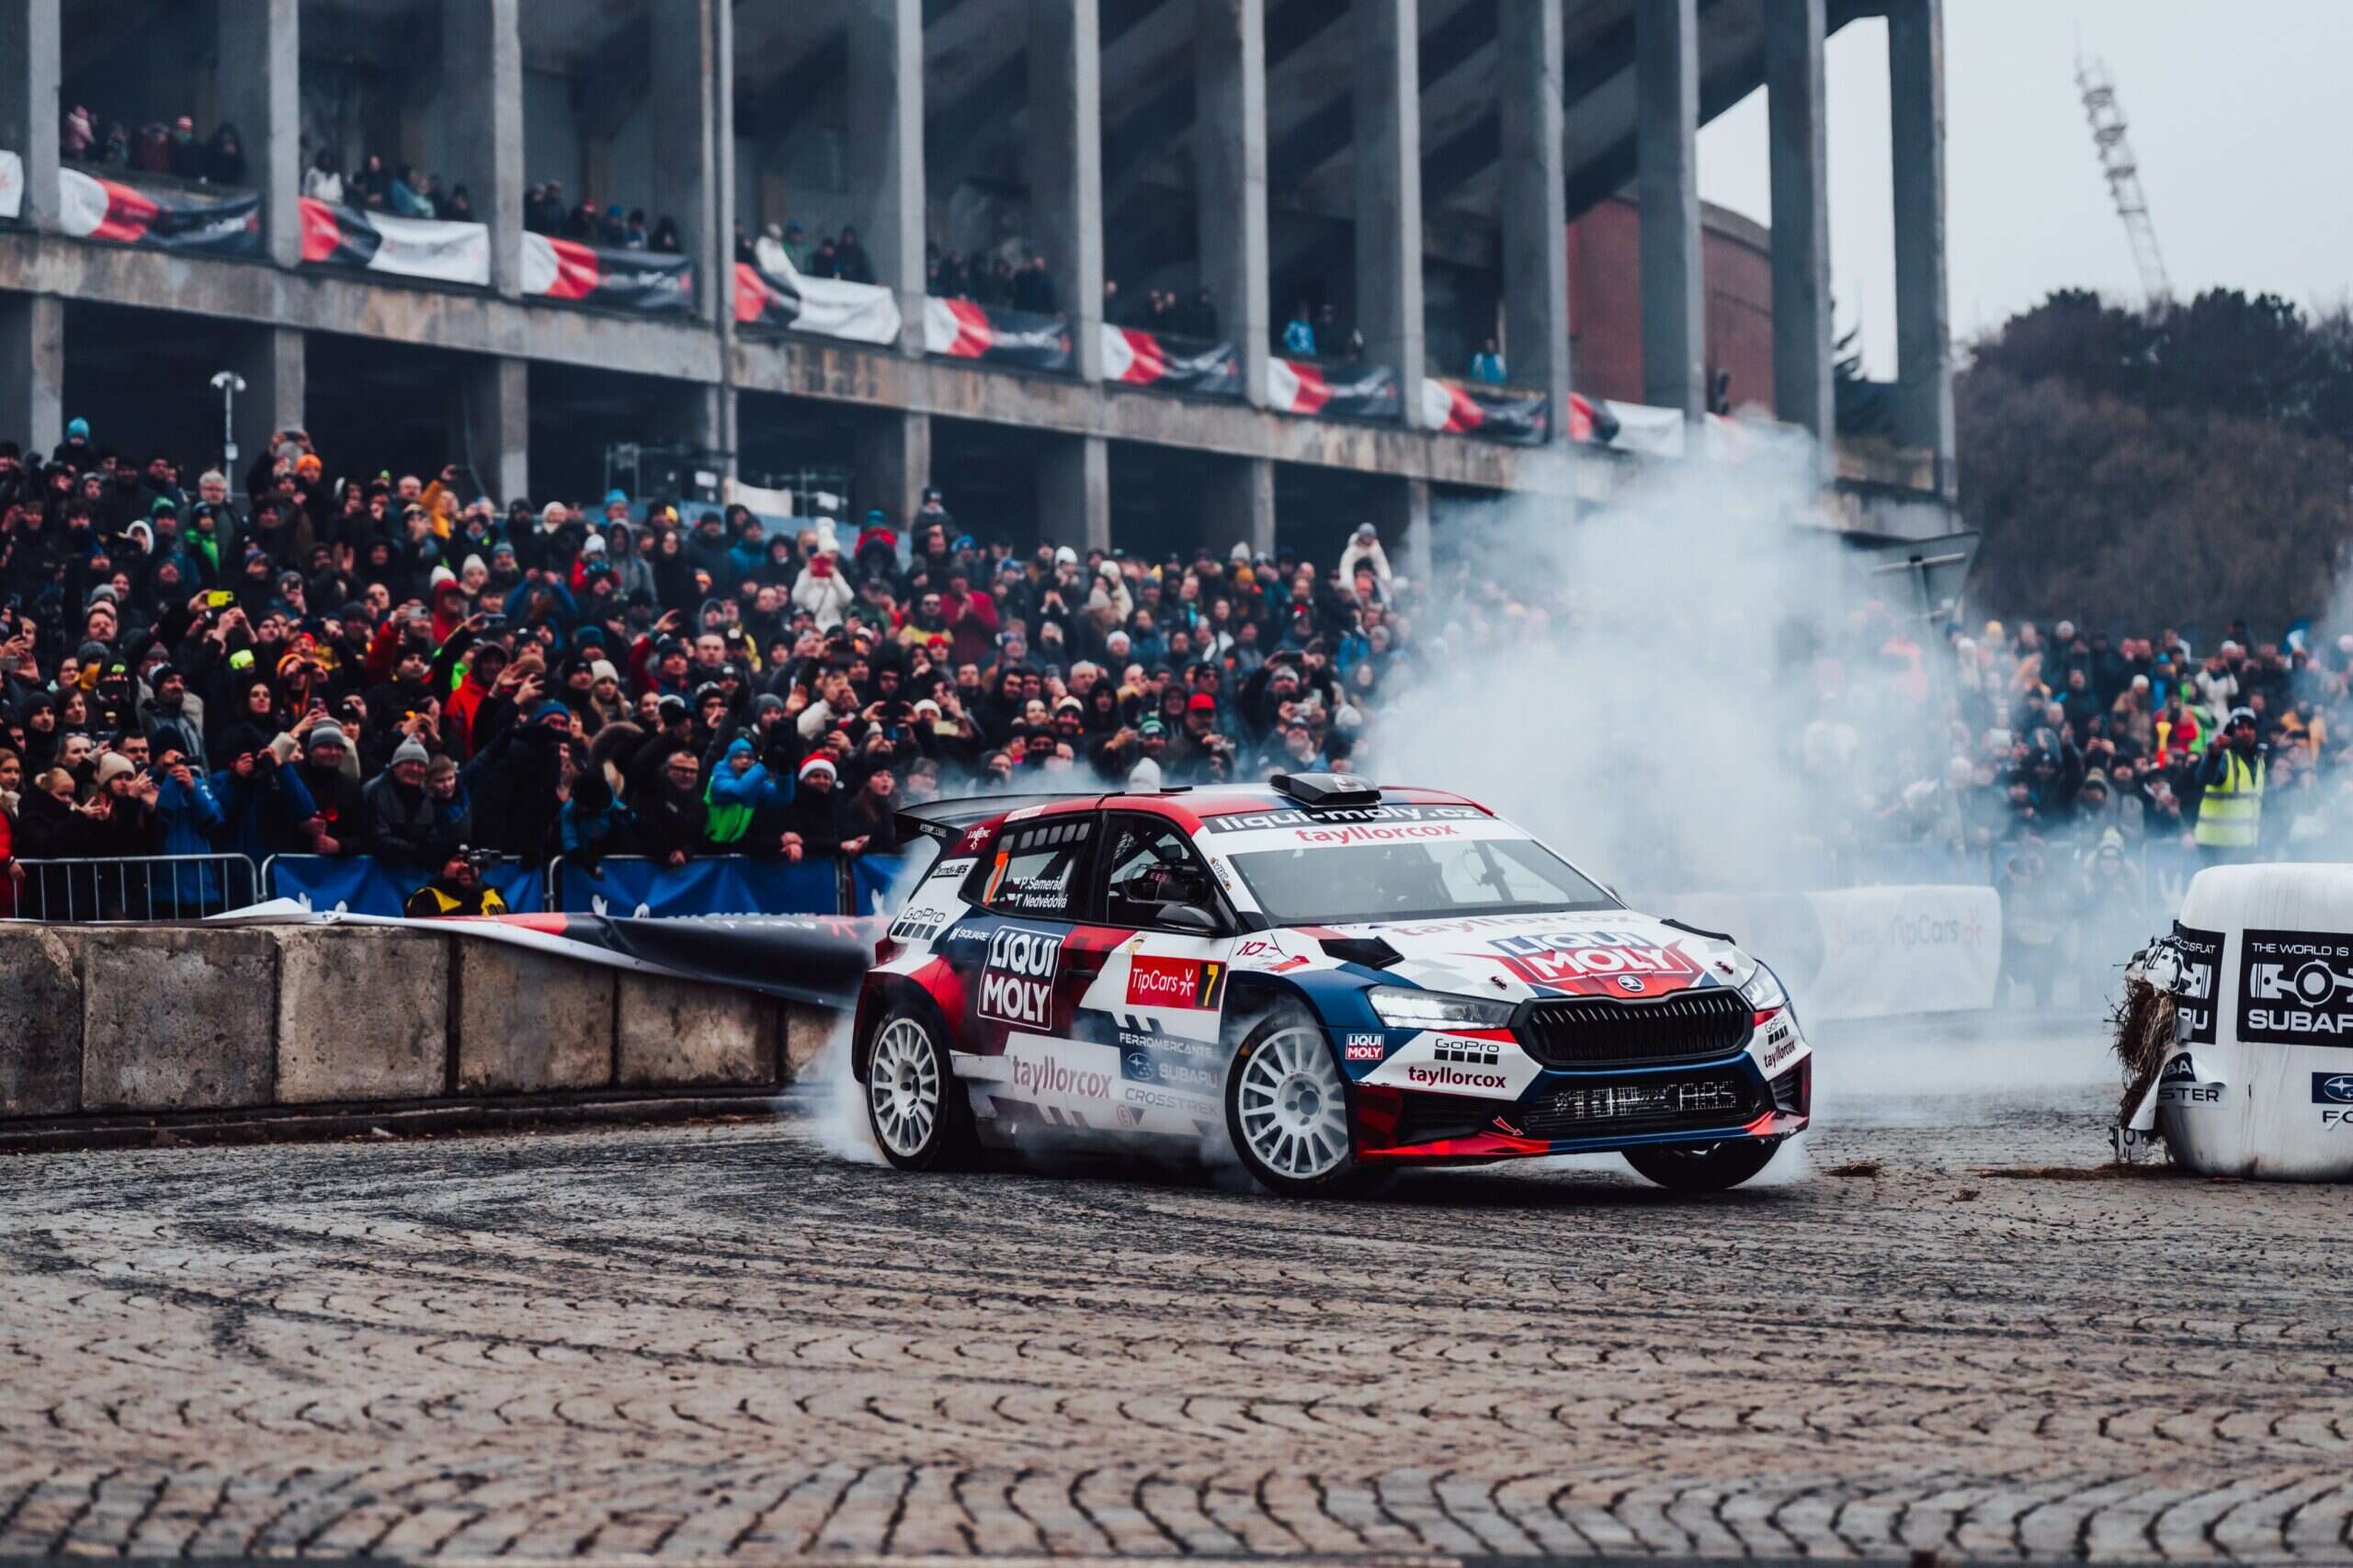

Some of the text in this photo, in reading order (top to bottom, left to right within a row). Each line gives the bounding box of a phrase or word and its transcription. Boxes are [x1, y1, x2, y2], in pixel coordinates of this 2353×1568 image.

[1215, 805, 1482, 832] liqui-moly.cz
[1295, 824, 1460, 845] tayllorcox
[904, 906, 946, 924] GoPro
[990, 930, 1059, 977] LIQUI
[1496, 931, 1652, 956] LIQUI
[2196, 943, 2217, 954] FLAT
[2252, 942, 2349, 958] THE WORLD IS
[1524, 947, 1674, 978] MOLY
[1132, 968, 1178, 995] TipCars
[1204, 963, 1220, 1007] 7
[983, 973, 1051, 1023] MOLY
[2248, 1008, 2353, 1035] SUBAR
[1119, 1031, 1213, 1059] FERROMERCANTE
[1347, 1047, 1382, 1059] MOLY
[1348, 1034, 1382, 1047] LIQUI
[1435, 1038, 1500, 1053] GoPro
[1764, 1040, 1797, 1069] tayllorcox
[1012, 1054, 1113, 1099] tayllorcox
[1157, 1062, 1222, 1089] SUBARU
[1408, 1065, 1507, 1088] tayllorcox
[1124, 1087, 1220, 1117] CROSSTREK
[2161, 1087, 2220, 1103] STER
